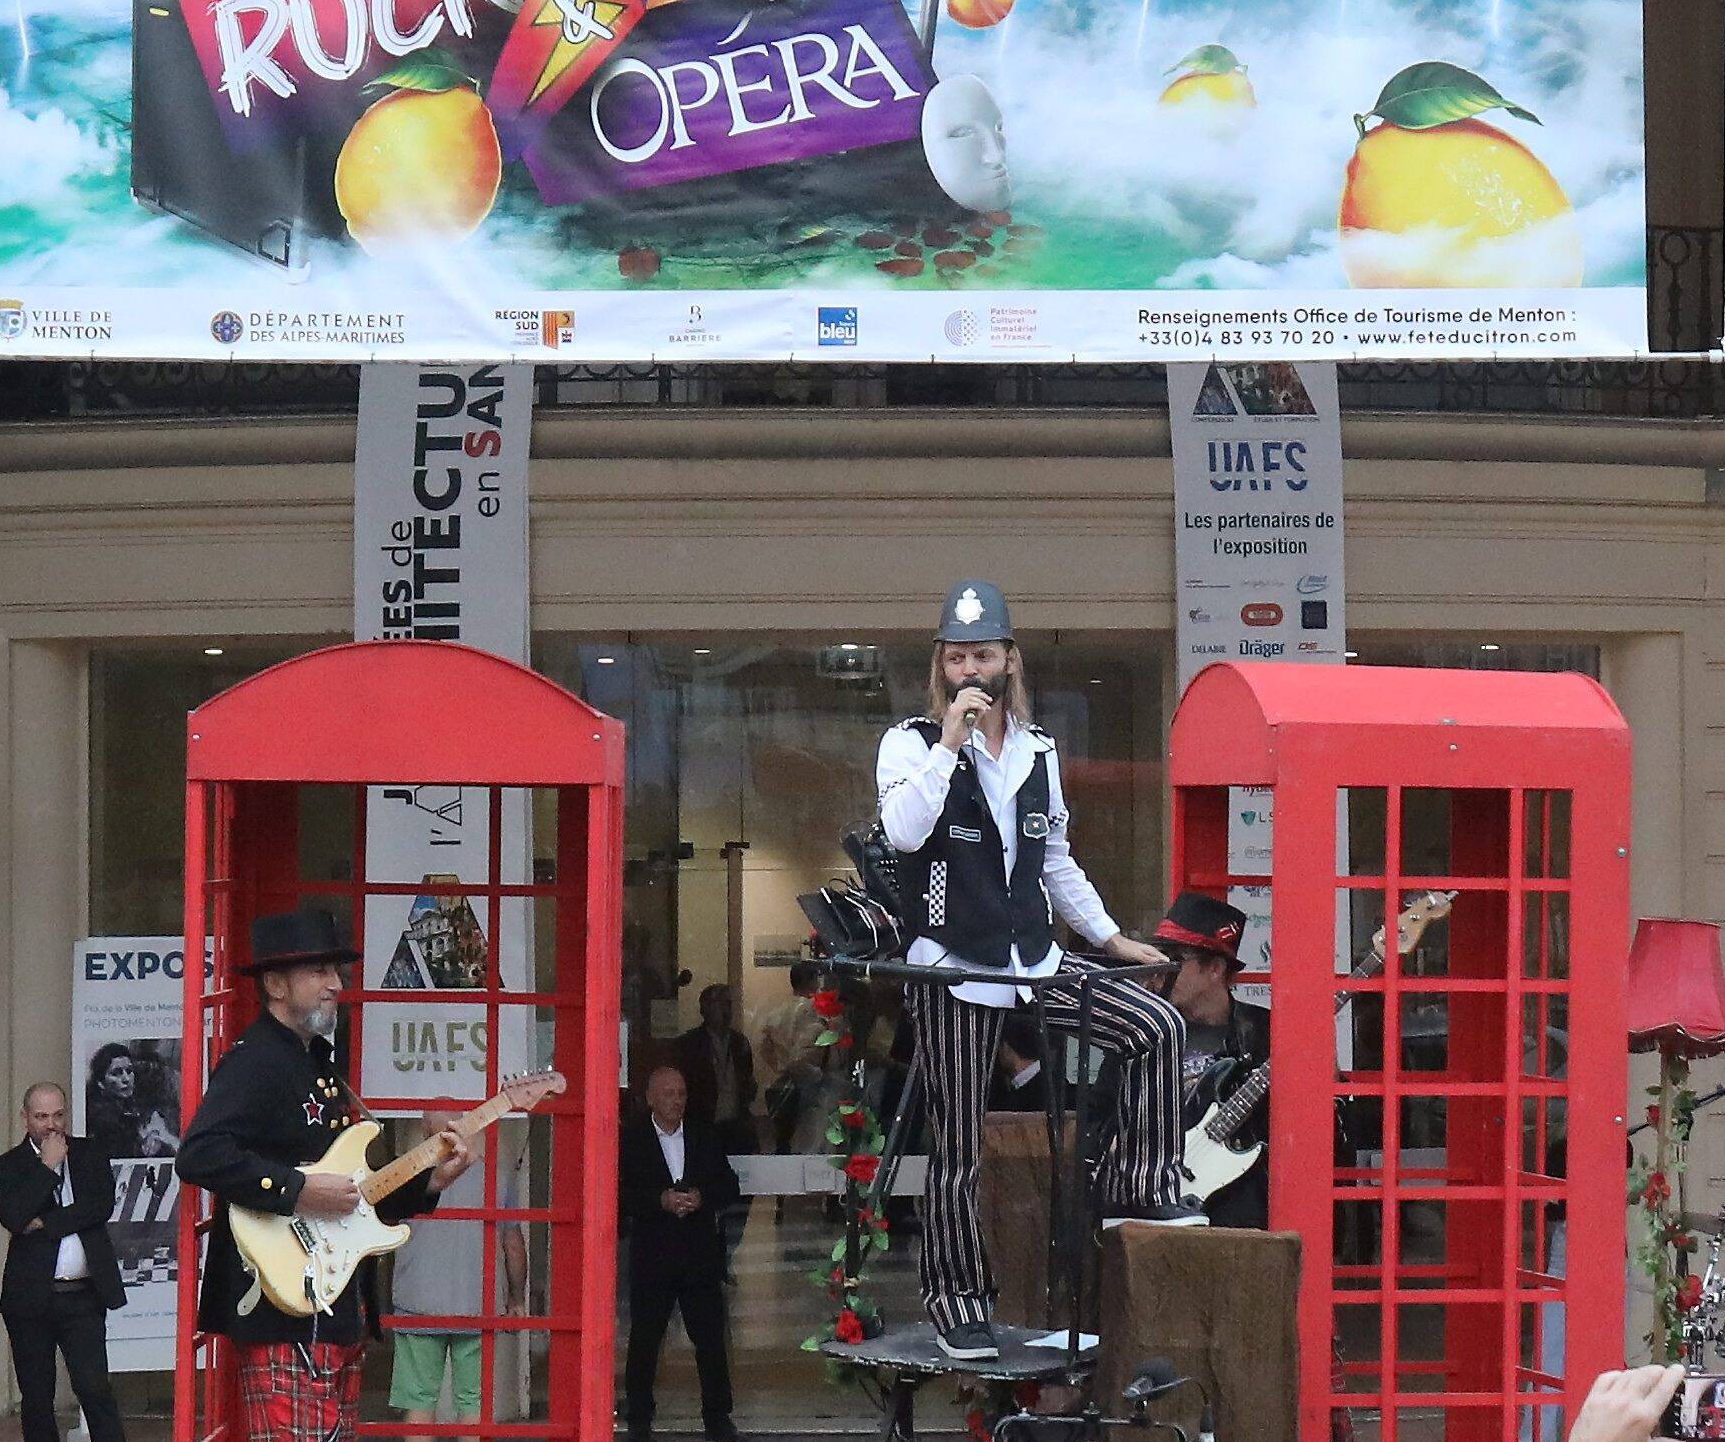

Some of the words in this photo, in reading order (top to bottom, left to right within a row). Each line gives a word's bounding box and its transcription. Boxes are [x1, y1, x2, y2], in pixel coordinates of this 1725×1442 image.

[591, 12, 920, 163] OPÉRA
[32, 310, 82, 323] VILLE
[89, 310, 113, 322] DE
[250, 309, 406, 328] DÉPARTEMENT
[1138, 309, 1288, 325] Renseignements
[1293, 308, 1348, 324] Office
[1354, 308, 1377, 323] de
[1384, 308, 1463, 323] Tourisme
[1468, 308, 1493, 323] de
[1498, 307, 1566, 322] Menton
[32, 326, 112, 340] MENTON
[515, 322, 539, 330] SUD
[819, 322, 856, 339] bleu
[250, 331, 275, 343] DES
[280, 331, 405, 344] ALPES-MARITIMES
[1138, 330, 1213, 346] +33(0)4
[1220, 331, 1243, 345] 83
[1250, 331, 1273, 344] 93
[1282, 331, 1304, 344] 70
[1311, 331, 1335, 344] 20
[1357, 329, 1577, 344] www.feteducitron.com
[1208, 441, 1308, 491] UAFS
[478, 471, 501, 517] en
[1185, 512, 1212, 528] Les
[1218, 512, 1310, 532] partenaires
[1315, 512, 1334, 528] de
[381, 520, 413, 567] de
[1213, 538, 1308, 557] l'exposition
[1239, 640, 1286, 657] Dräger
